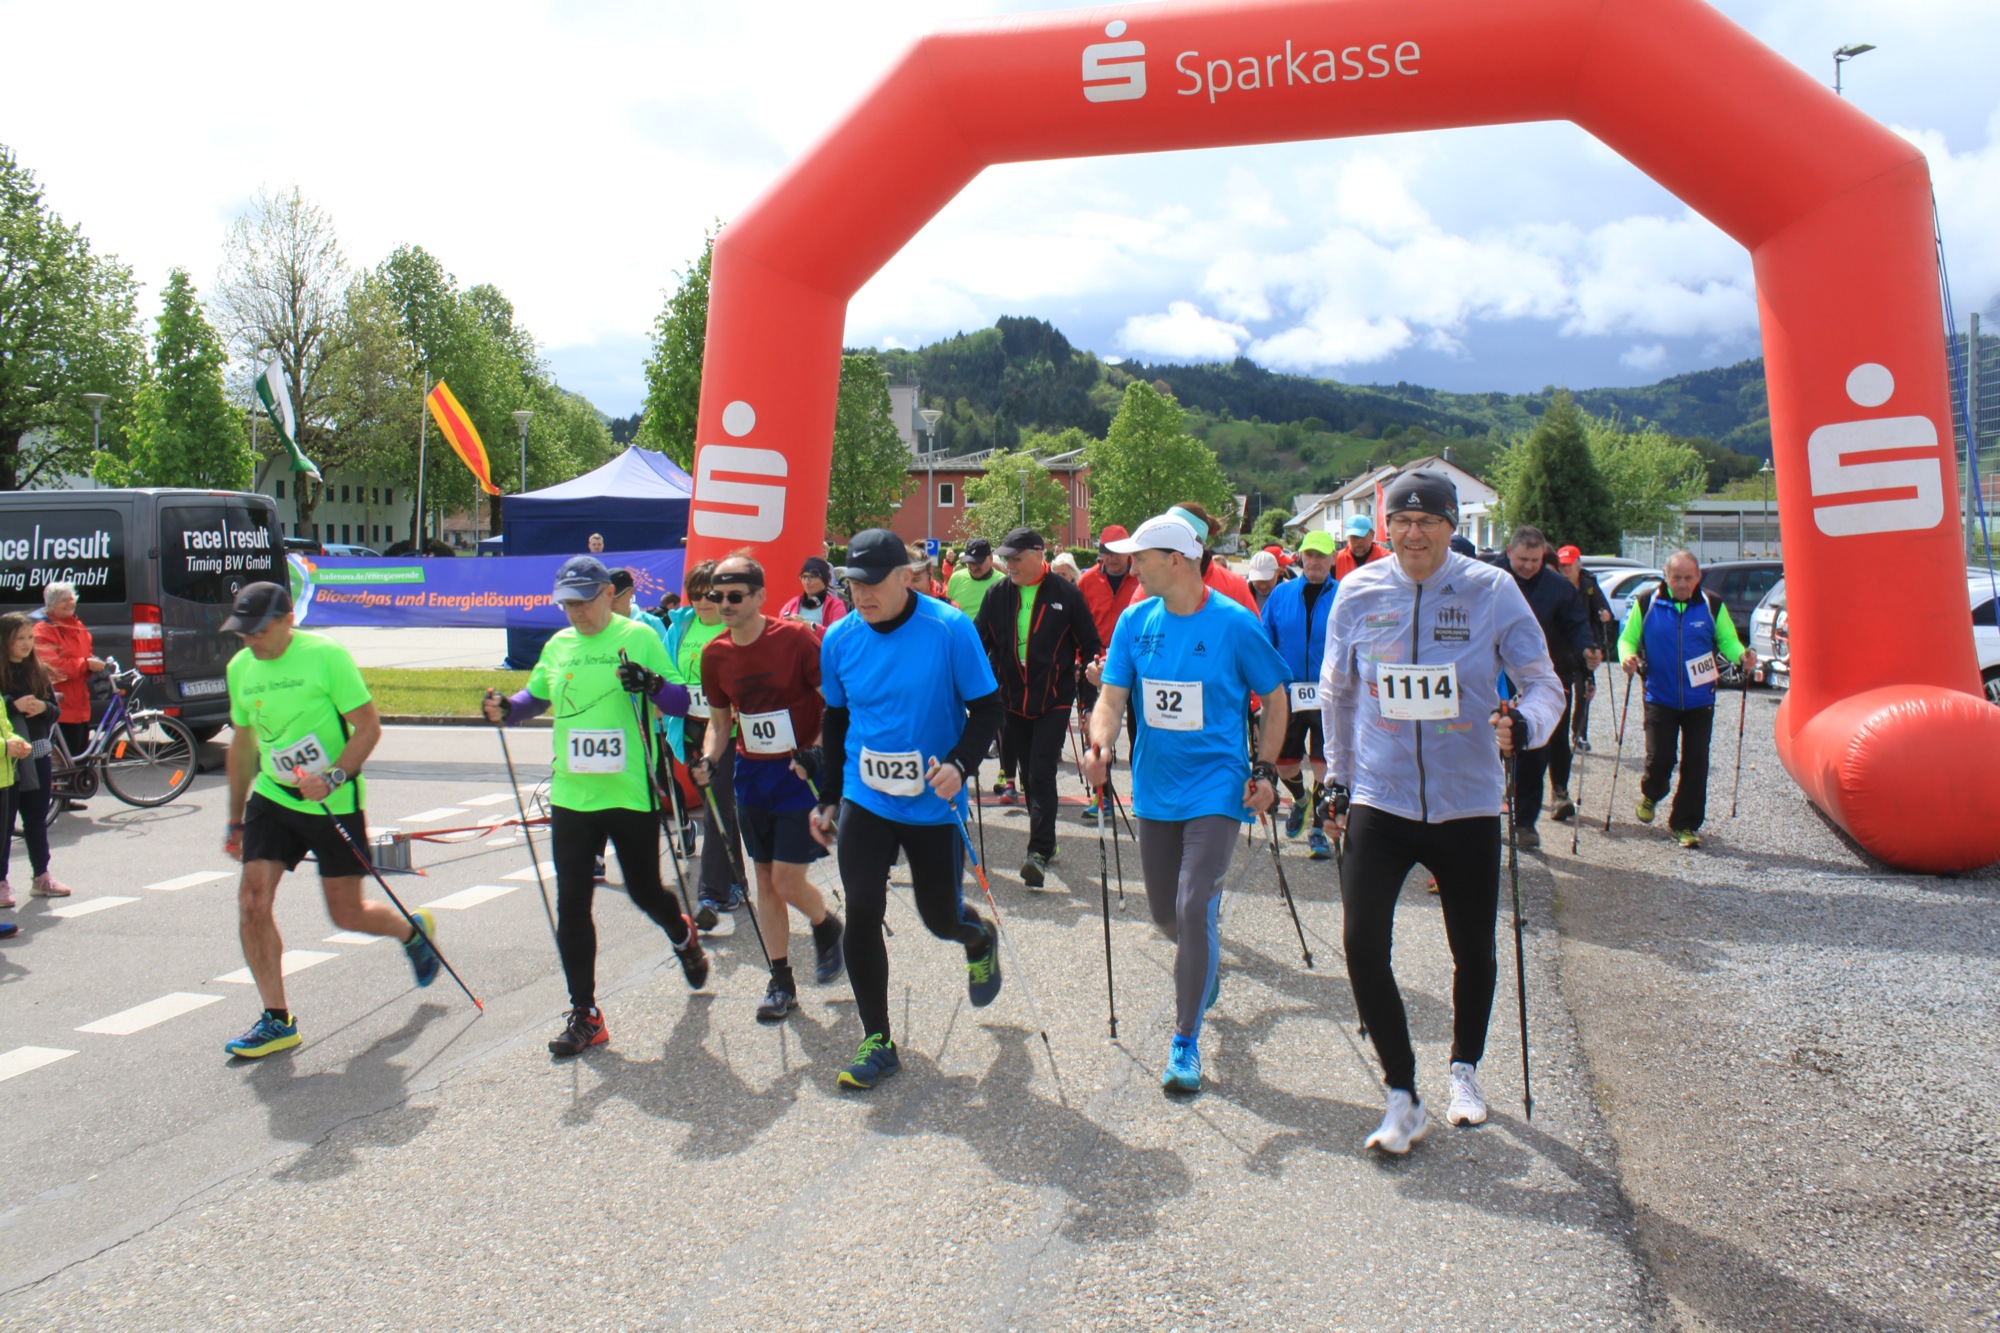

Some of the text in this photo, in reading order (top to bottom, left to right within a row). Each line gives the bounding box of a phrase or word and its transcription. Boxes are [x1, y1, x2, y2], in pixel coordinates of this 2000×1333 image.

[1175, 40, 1421, 104] Sparkasse
[186, 554, 271, 574] Timing BW GmbH
[29, 568, 60, 586] BW
[61, 567, 109, 586] GmbH
[320, 571, 419, 581] badenova.de/energiewende
[316, 589, 553, 611] Bioerdgas und Energielösungen
[1690, 658, 1714, 676] 1082
[1298, 687, 1316, 700] 60
[1383, 674, 1452, 699] 1114
[1156, 689, 1182, 712] 32
[752, 720, 777, 739] 40
[272, 742, 320, 772] 1045
[571, 737, 622, 757] 1043
[864, 757, 918, 780] 1023
